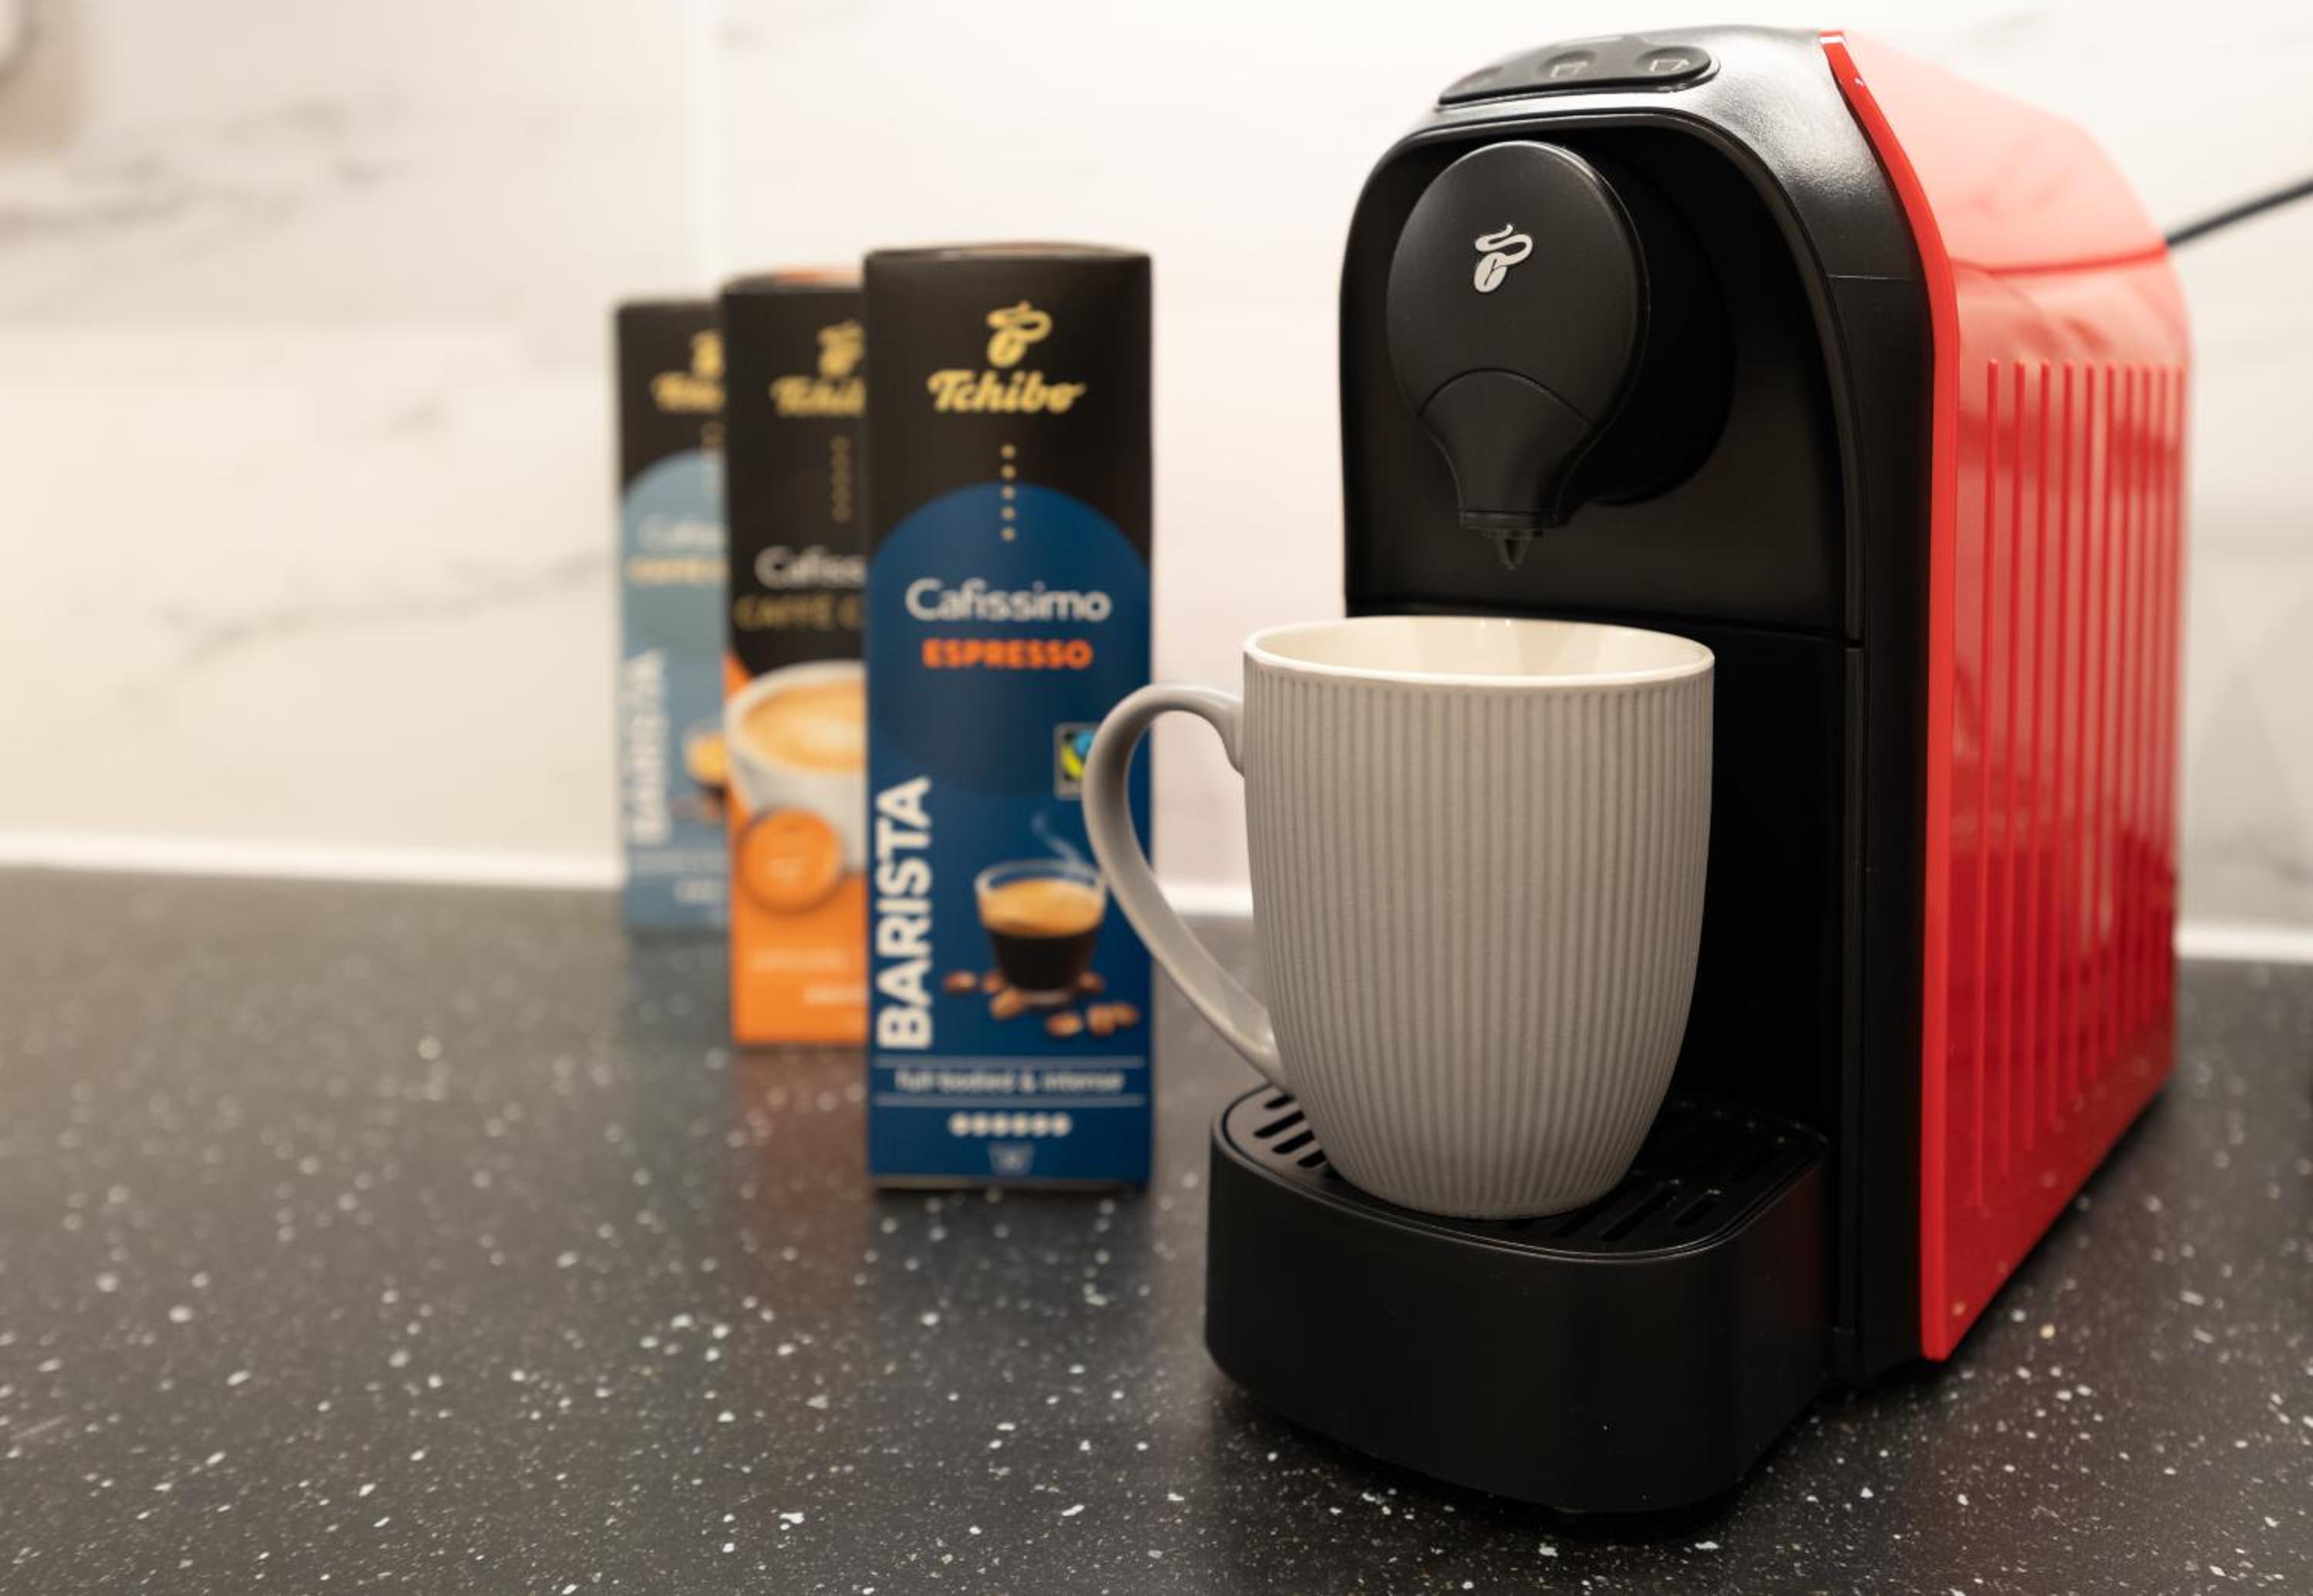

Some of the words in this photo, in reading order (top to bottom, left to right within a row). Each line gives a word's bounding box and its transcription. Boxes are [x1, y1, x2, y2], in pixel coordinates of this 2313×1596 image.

[928, 369, 1086, 414] Tchibo
[904, 577, 1112, 622] Cafissimo
[922, 638, 1093, 670] ESPRESSO
[876, 776, 933, 1049] BARISTA
